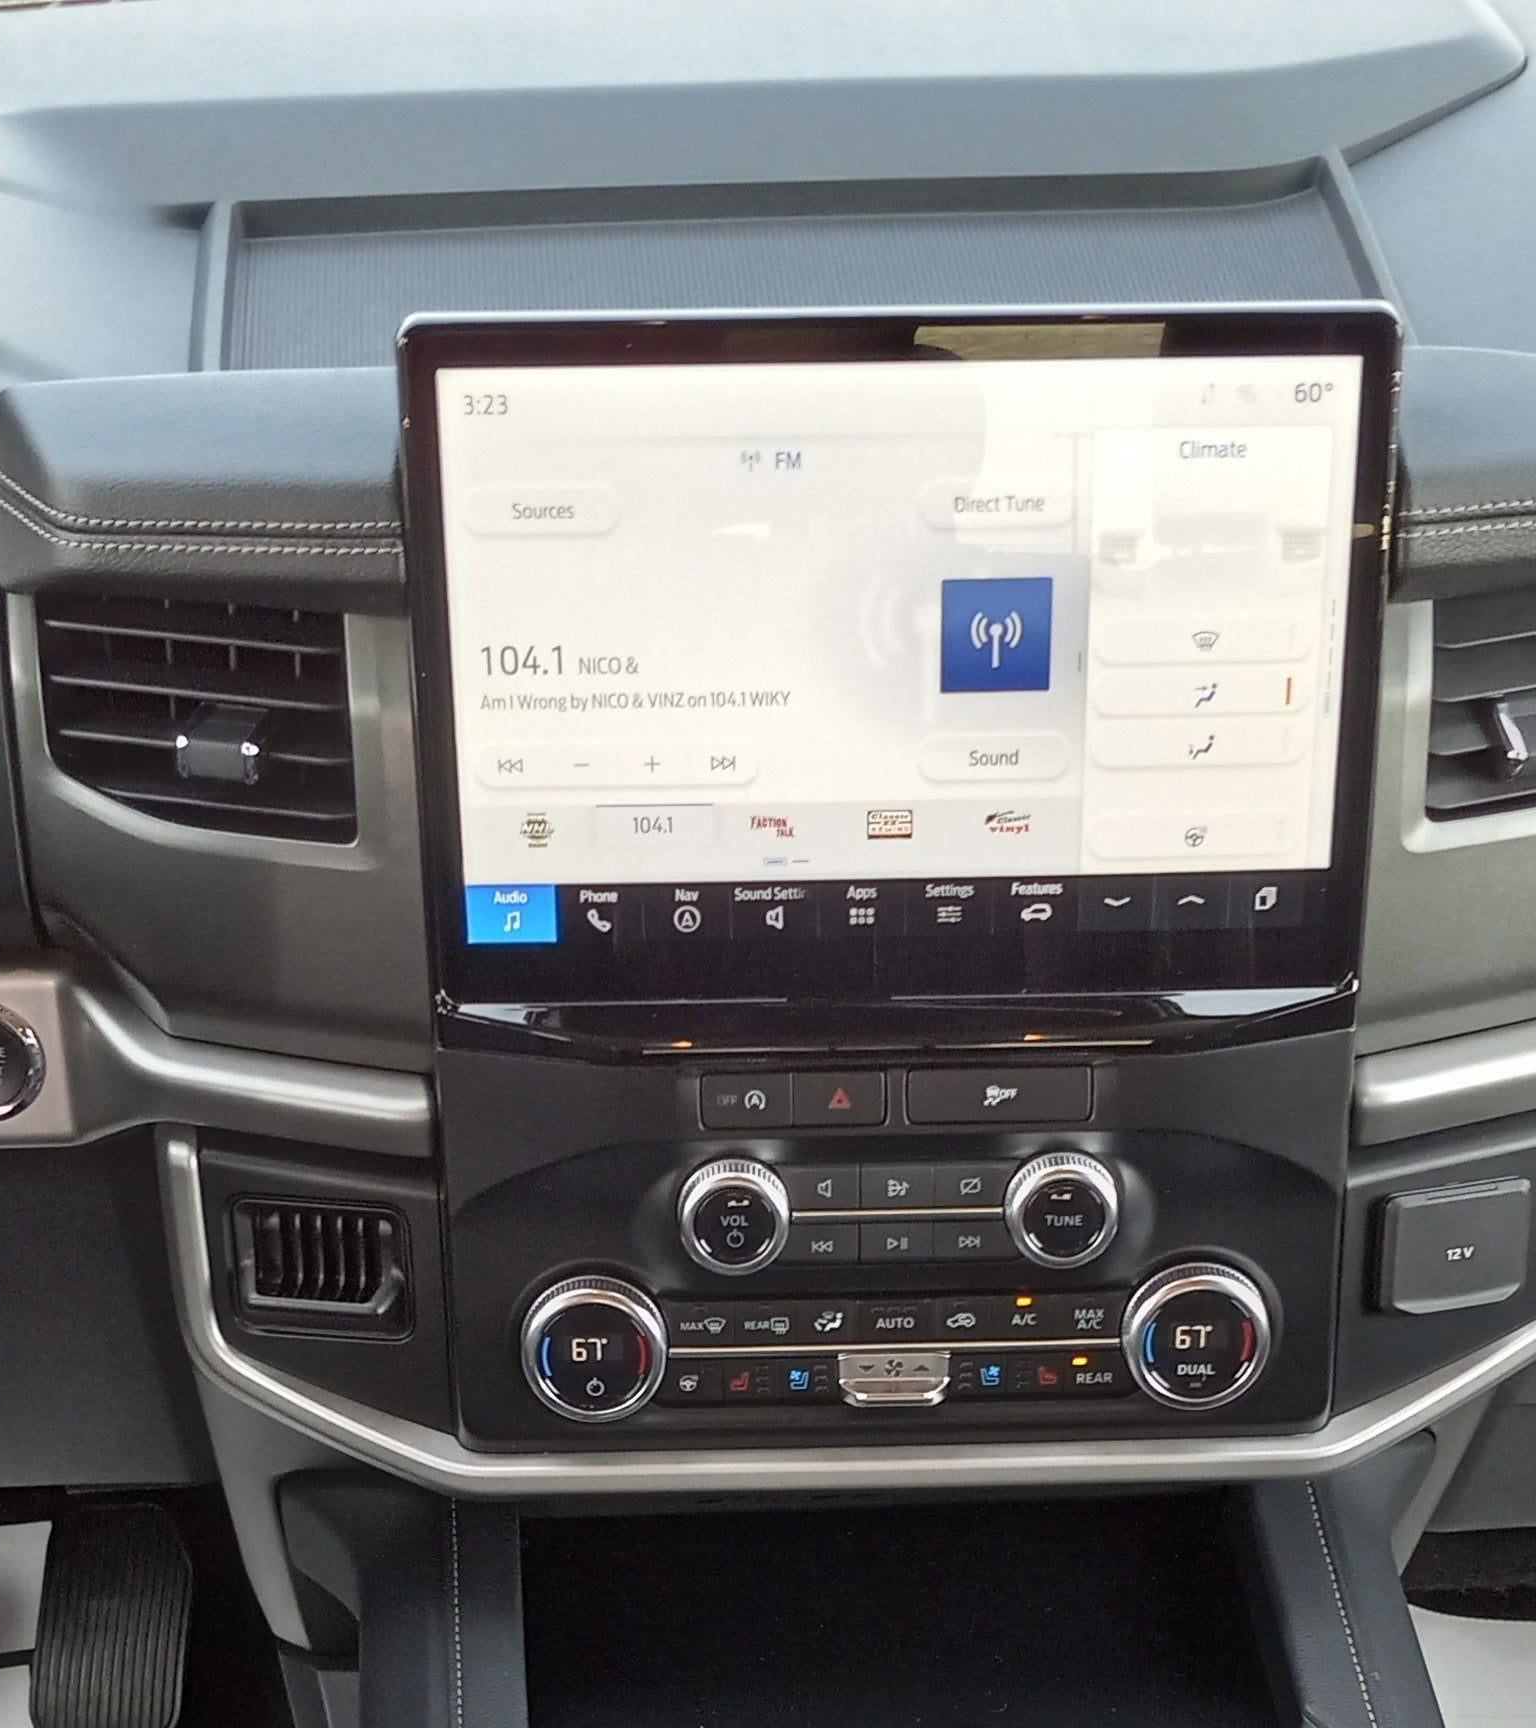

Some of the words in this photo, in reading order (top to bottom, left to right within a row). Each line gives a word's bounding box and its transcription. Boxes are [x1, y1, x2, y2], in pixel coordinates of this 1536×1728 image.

[1294, 383, 1334, 403] 60°
[464, 394, 509, 416] 3:23
[1178, 439, 1247, 460] Climate
[774, 452, 802, 470] FM
[511, 501, 575, 521] Sources
[953, 495, 1001, 514] Direct
[1004, 495, 1046, 513] Tune
[480, 646, 565, 677] 104.1
[577, 656, 621, 675] NICO
[625, 657, 640, 675] &
[480, 694, 506, 711] Am
[517, 693, 568, 713] Wrong
[569, 694, 588, 713] by
[591, 693, 629, 710] NICO
[631, 694, 644, 709] &
[647, 692, 685, 708] VINZ
[687, 695, 707, 708] on
[709, 692, 747, 708] 104.1
[750, 690, 792, 707] WIKY
[968, 748, 1020, 768] Sound
[632, 816, 673, 834] 104.1
[579, 889, 618, 905] Phone
[675, 888, 699, 902] Nav
[734, 886, 772, 901] Sound
[846, 885, 878, 902] Apps
[924, 883, 975, 899] Settings
[1010, 881, 1063, 897] Features
[493, 890, 528, 905] Audio
[720, 1215, 750, 1228] VOL
[1045, 1214, 1084, 1228] TUNE
[1011, 1313, 1037, 1326] A/C
[1075, 1308, 1105, 1320] MAX
[680, 1321, 704, 1331] MAX
[875, 1315, 916, 1330] AUTO
[1076, 1318, 1103, 1331] A/C
[1075, 1371, 1113, 1384] REAR
[1176, 1363, 1217, 1376] DUAL
